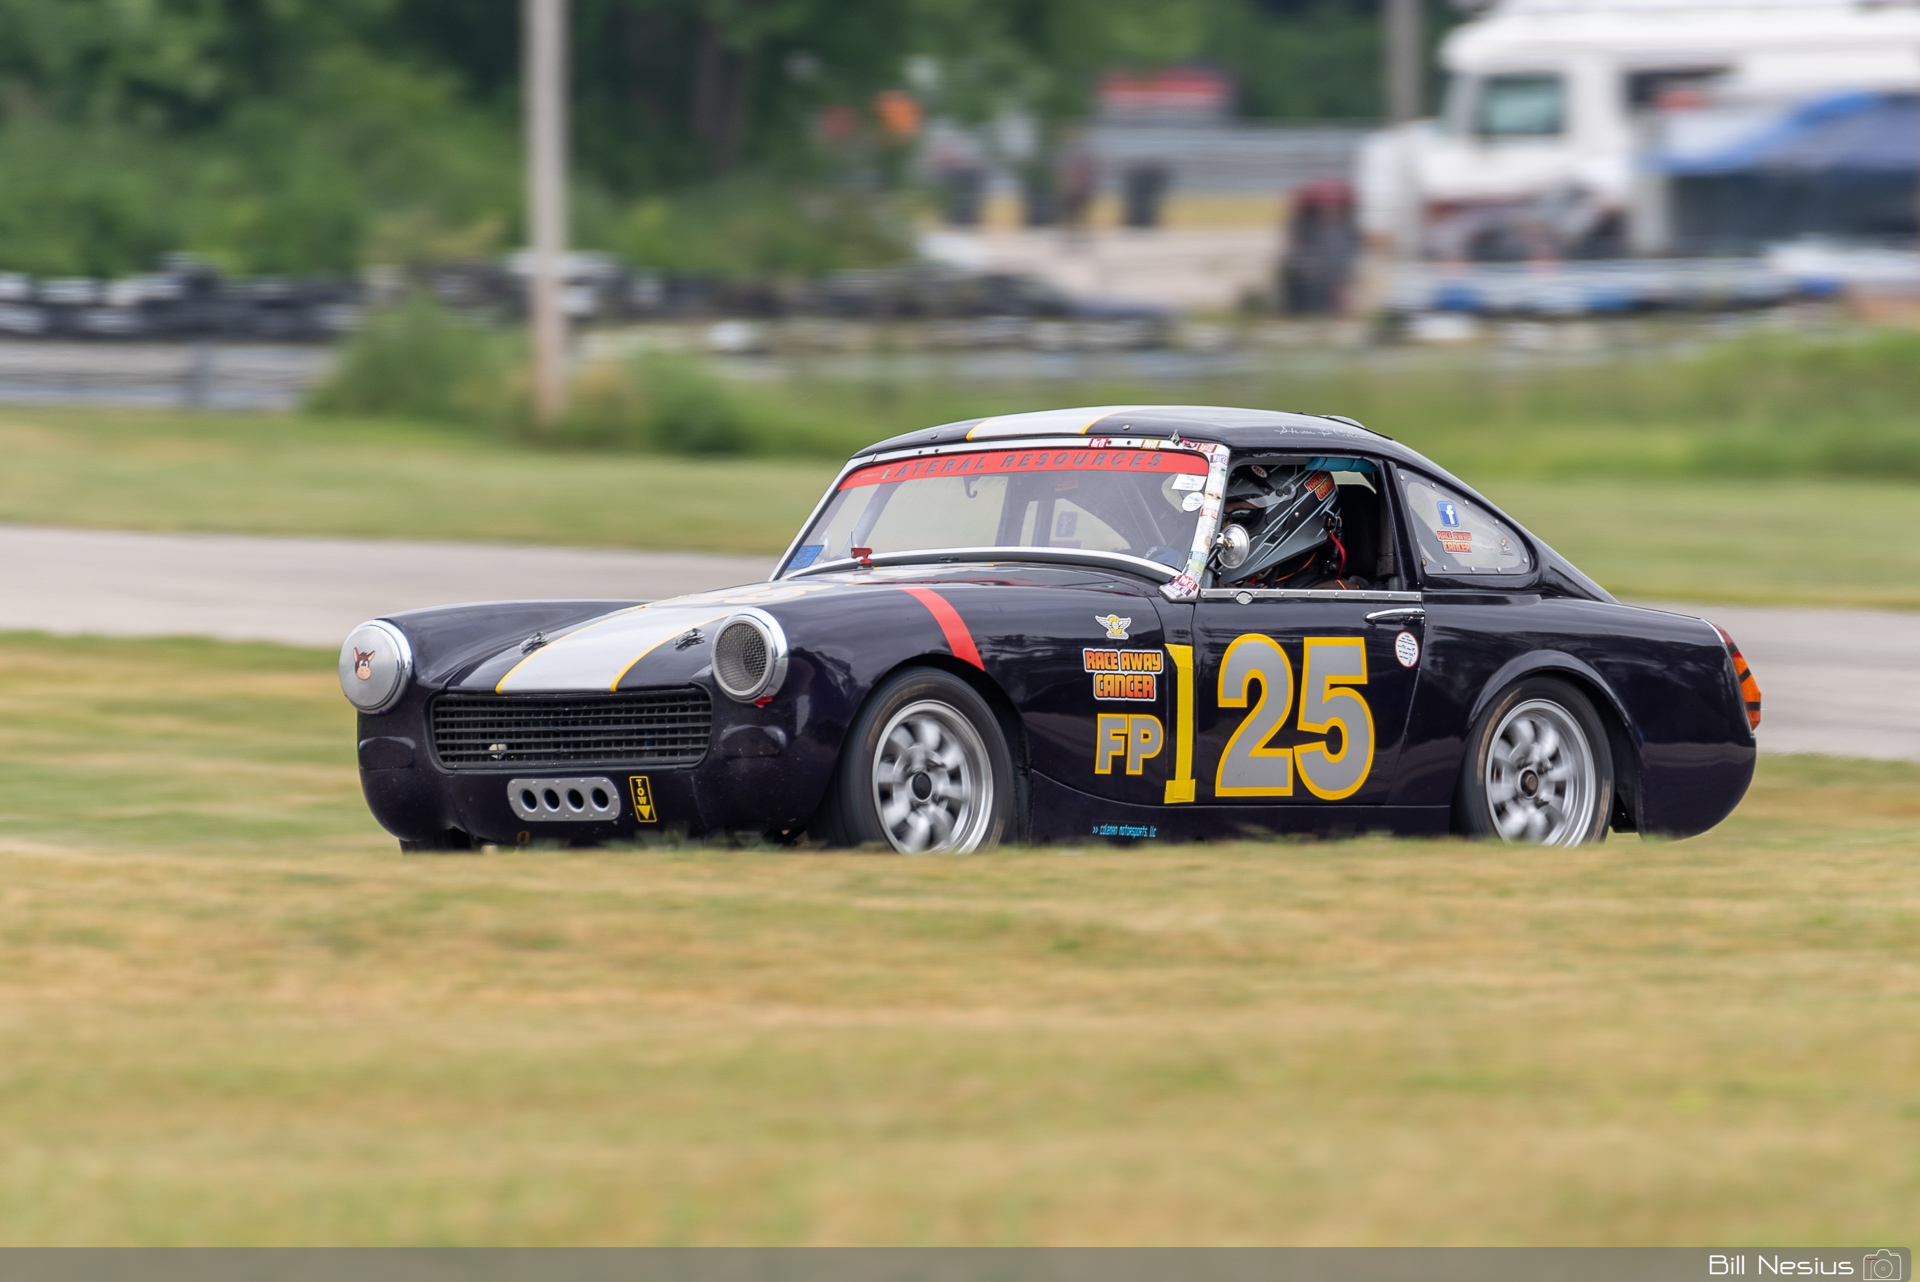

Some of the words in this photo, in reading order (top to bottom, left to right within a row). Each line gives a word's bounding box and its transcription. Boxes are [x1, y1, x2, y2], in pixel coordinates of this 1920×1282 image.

[881, 457, 985, 480] LATERAL
[1000, 452, 1164, 468] RESOURCES
[1085, 651, 1118, 670] RACE
[1120, 652, 1162, 671] AWAY
[1095, 674, 1154, 698] CANCER
[1094, 713, 1163, 775] FP
[635, 779, 647, 804] TOW
